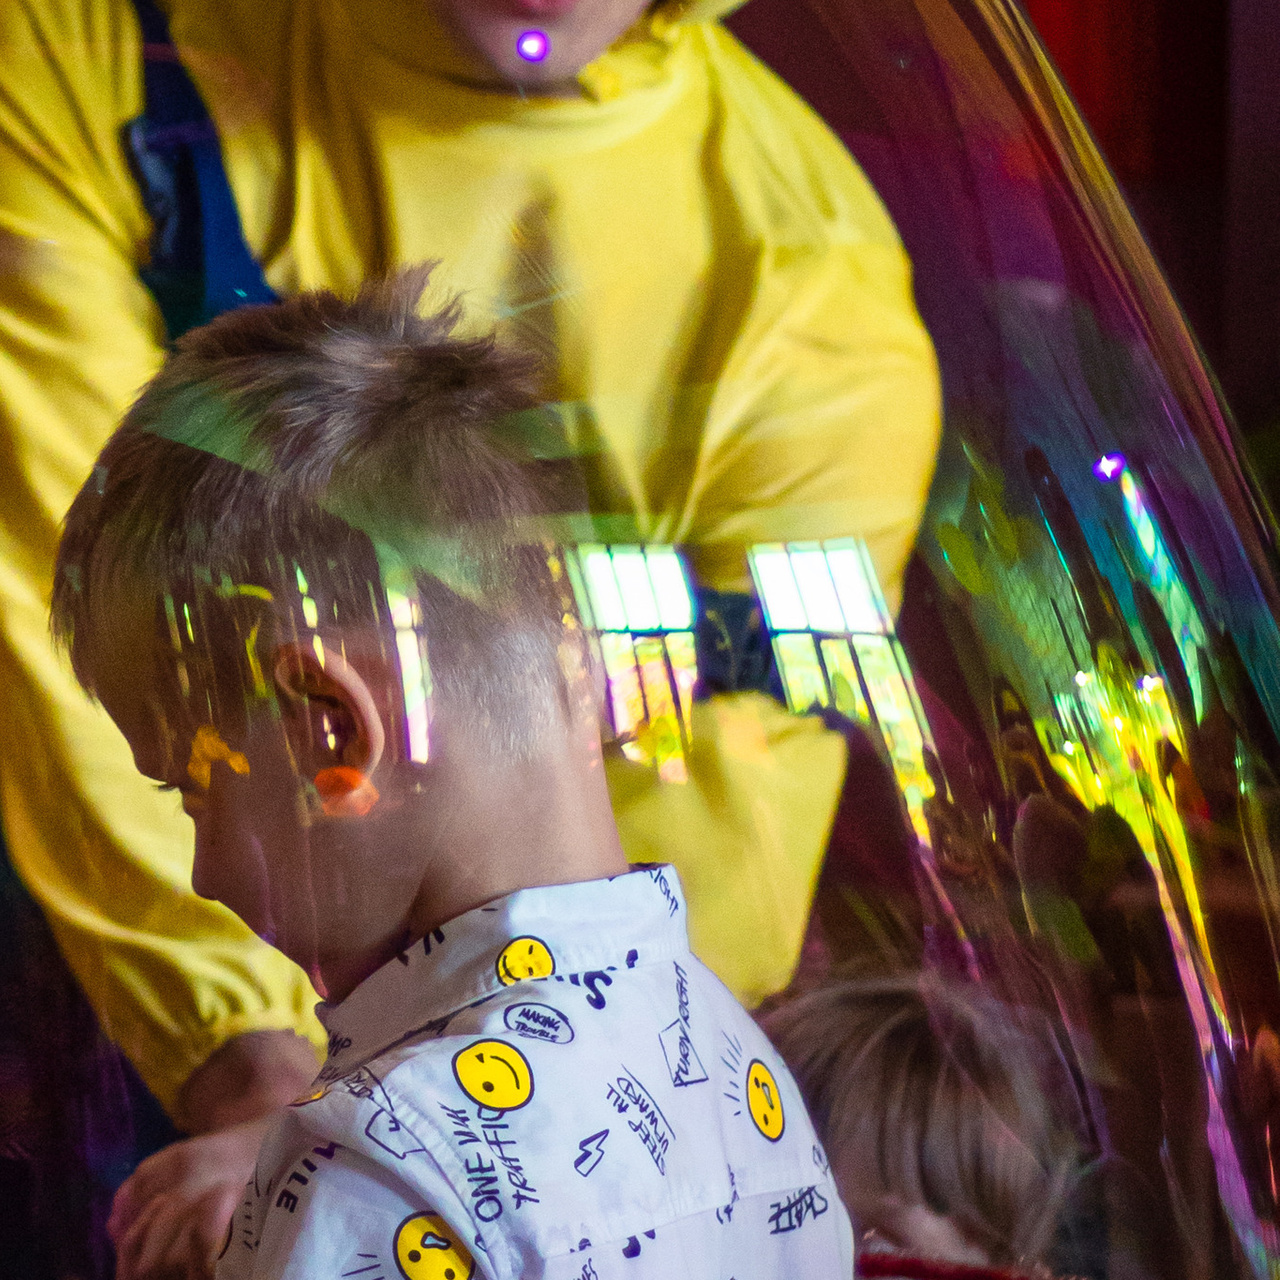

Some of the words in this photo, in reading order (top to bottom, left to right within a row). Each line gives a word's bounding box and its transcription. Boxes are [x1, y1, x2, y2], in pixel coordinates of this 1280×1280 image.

[515, 1020, 560, 1041] TROUBLE
[517, 1008, 561, 1031] MAKING
[465, 1152, 503, 1223] ONE
